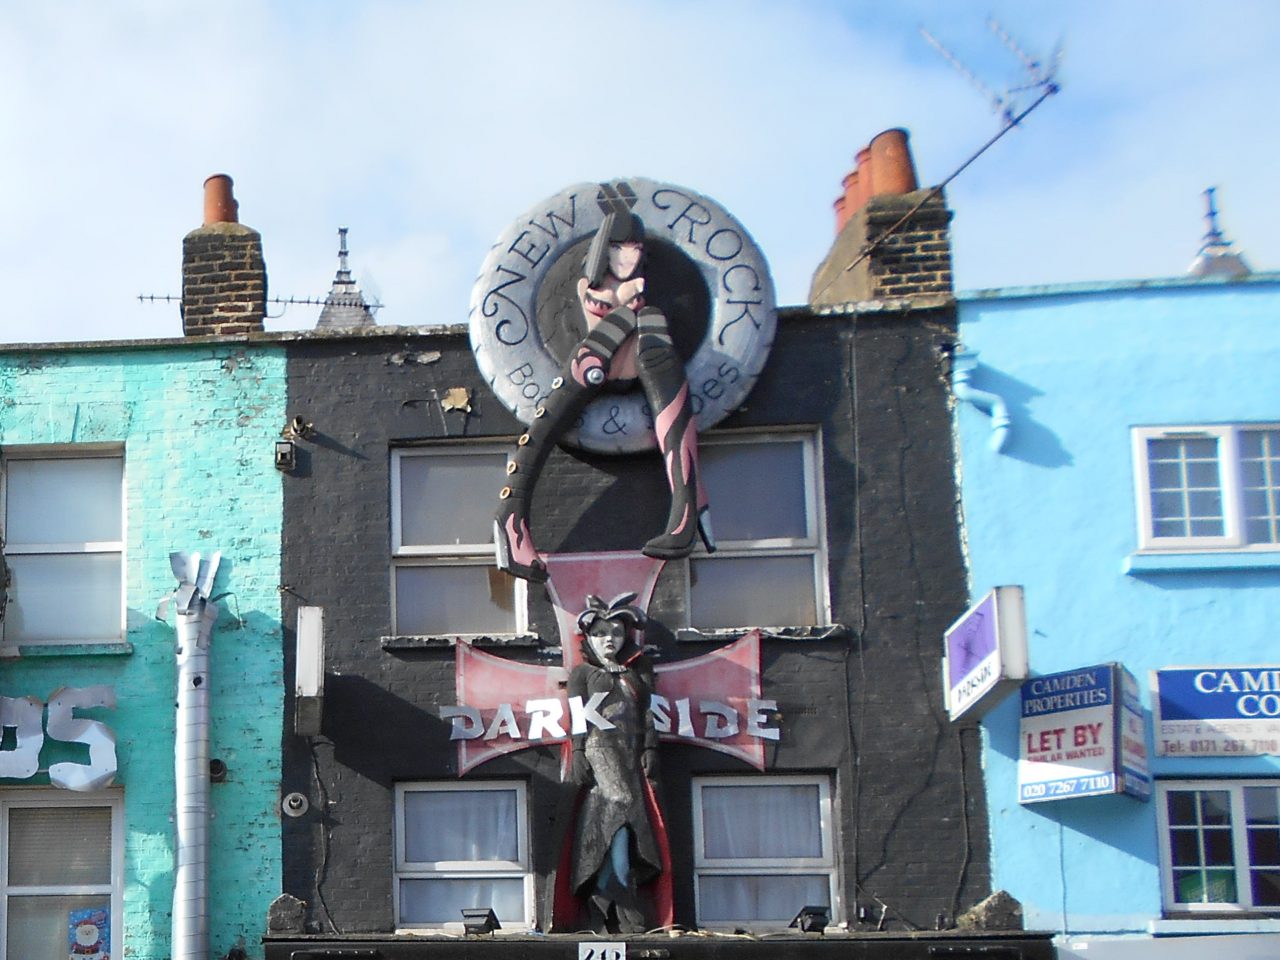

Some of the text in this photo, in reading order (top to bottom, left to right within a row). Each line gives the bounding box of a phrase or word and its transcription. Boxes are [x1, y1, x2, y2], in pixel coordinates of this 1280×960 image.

[482, 188, 763, 346] NEW ROCK
[602, 406, 627, 436] &
[1031, 671, 1097, 696] CAMDEN
[1024, 686, 1108, 714] PROPERTIES
[439, 691, 781, 741] DARK SIDE
[1026, 722, 1103, 754] LET BY
[1065, 746, 1106, 760] WANTED
[1023, 775, 1109, 797] 020 7267 7110
